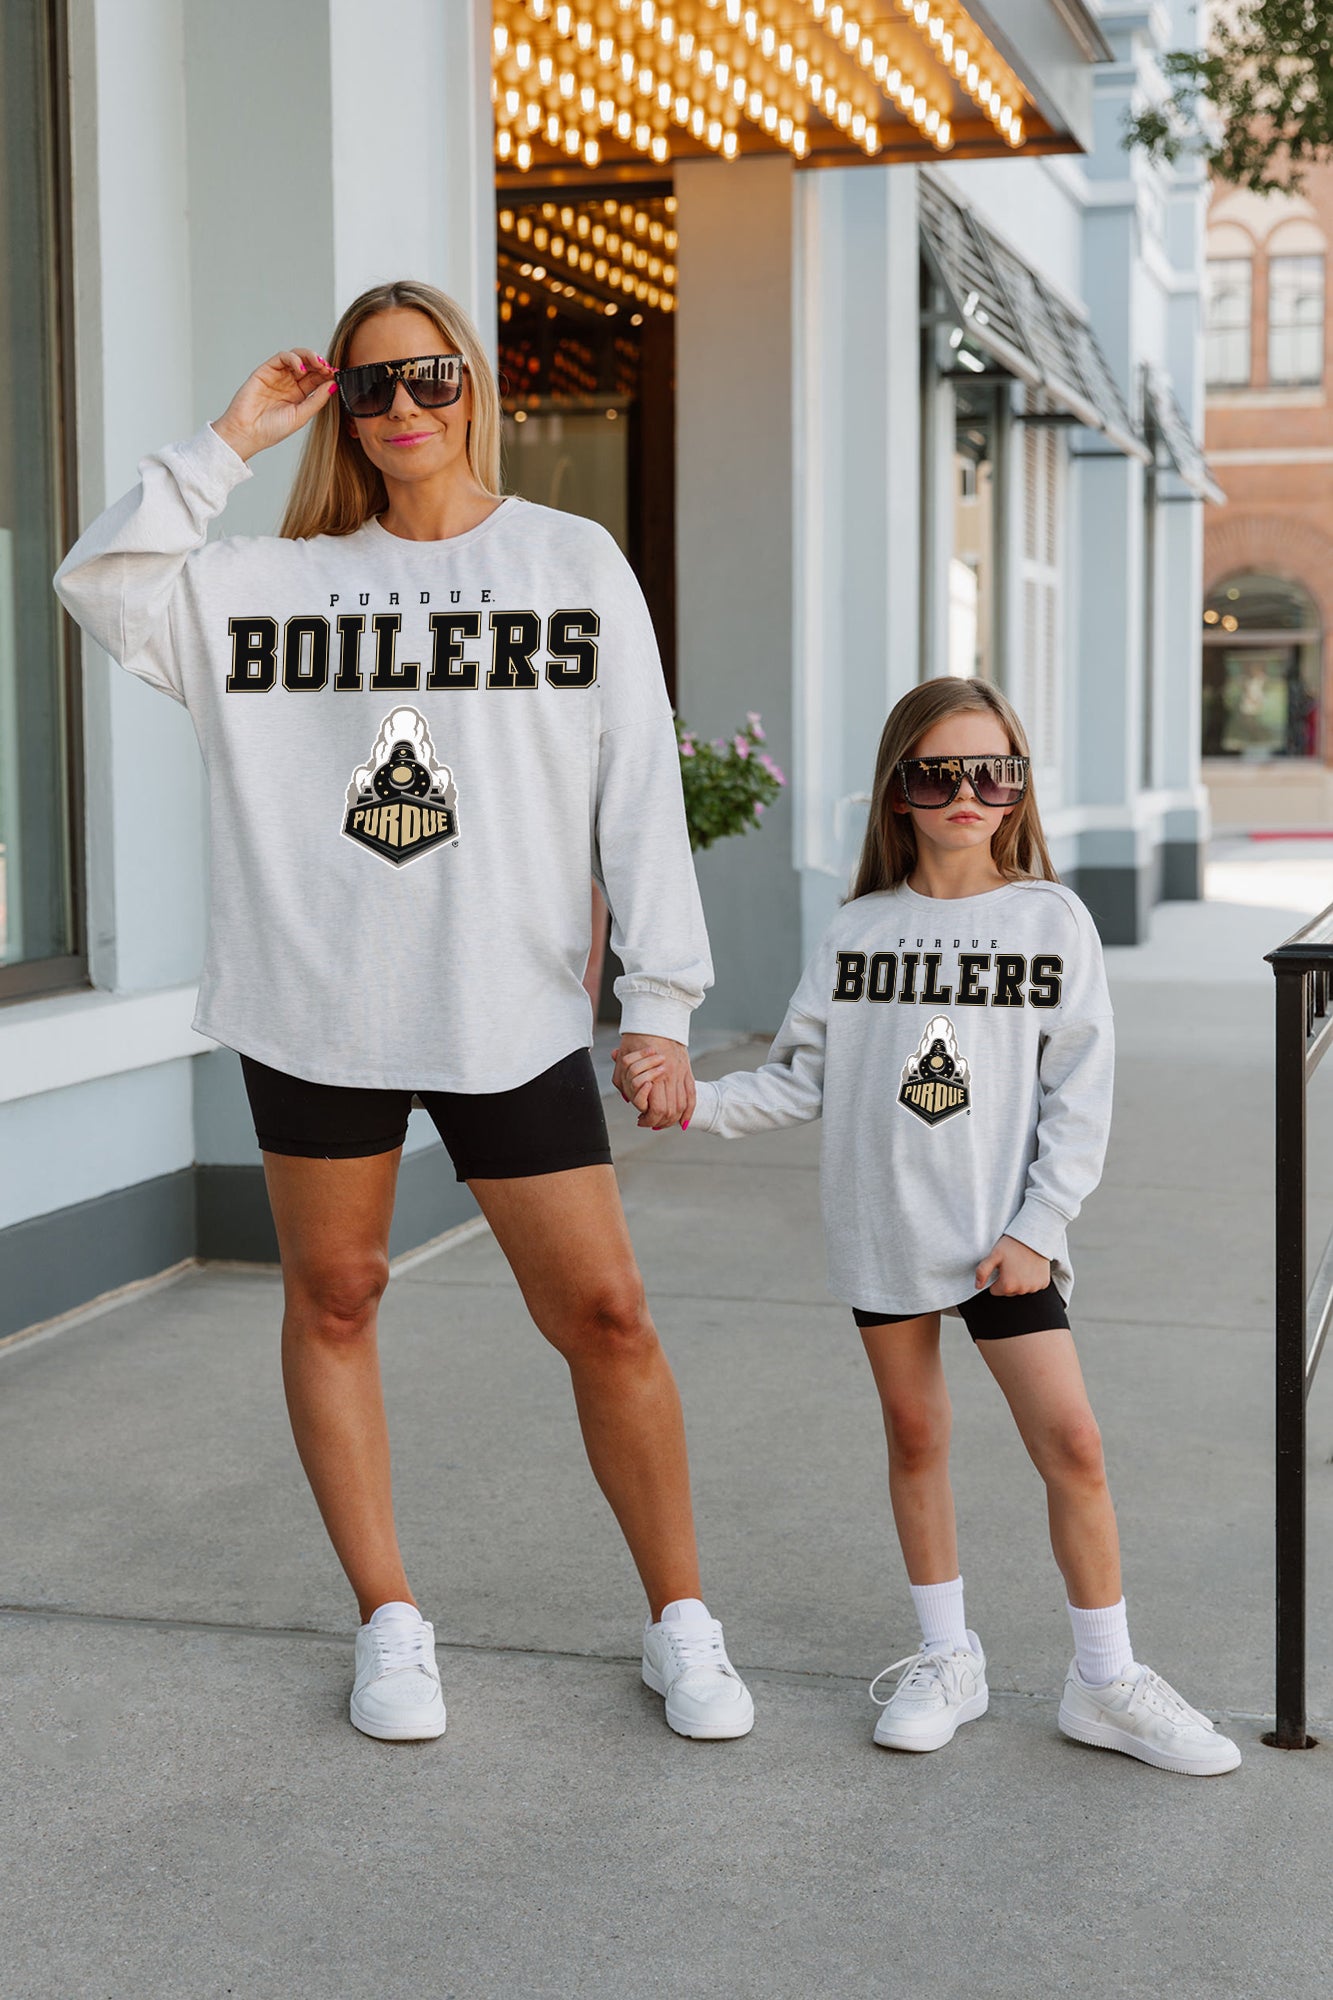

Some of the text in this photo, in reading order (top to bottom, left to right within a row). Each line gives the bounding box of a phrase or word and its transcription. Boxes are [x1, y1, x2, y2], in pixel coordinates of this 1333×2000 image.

[226, 608, 601, 693] BOILERS
[352, 803, 448, 848] PURDUE
[831, 951, 1064, 1009] BOILERS
[904, 1082, 965, 1113] PURDUE
